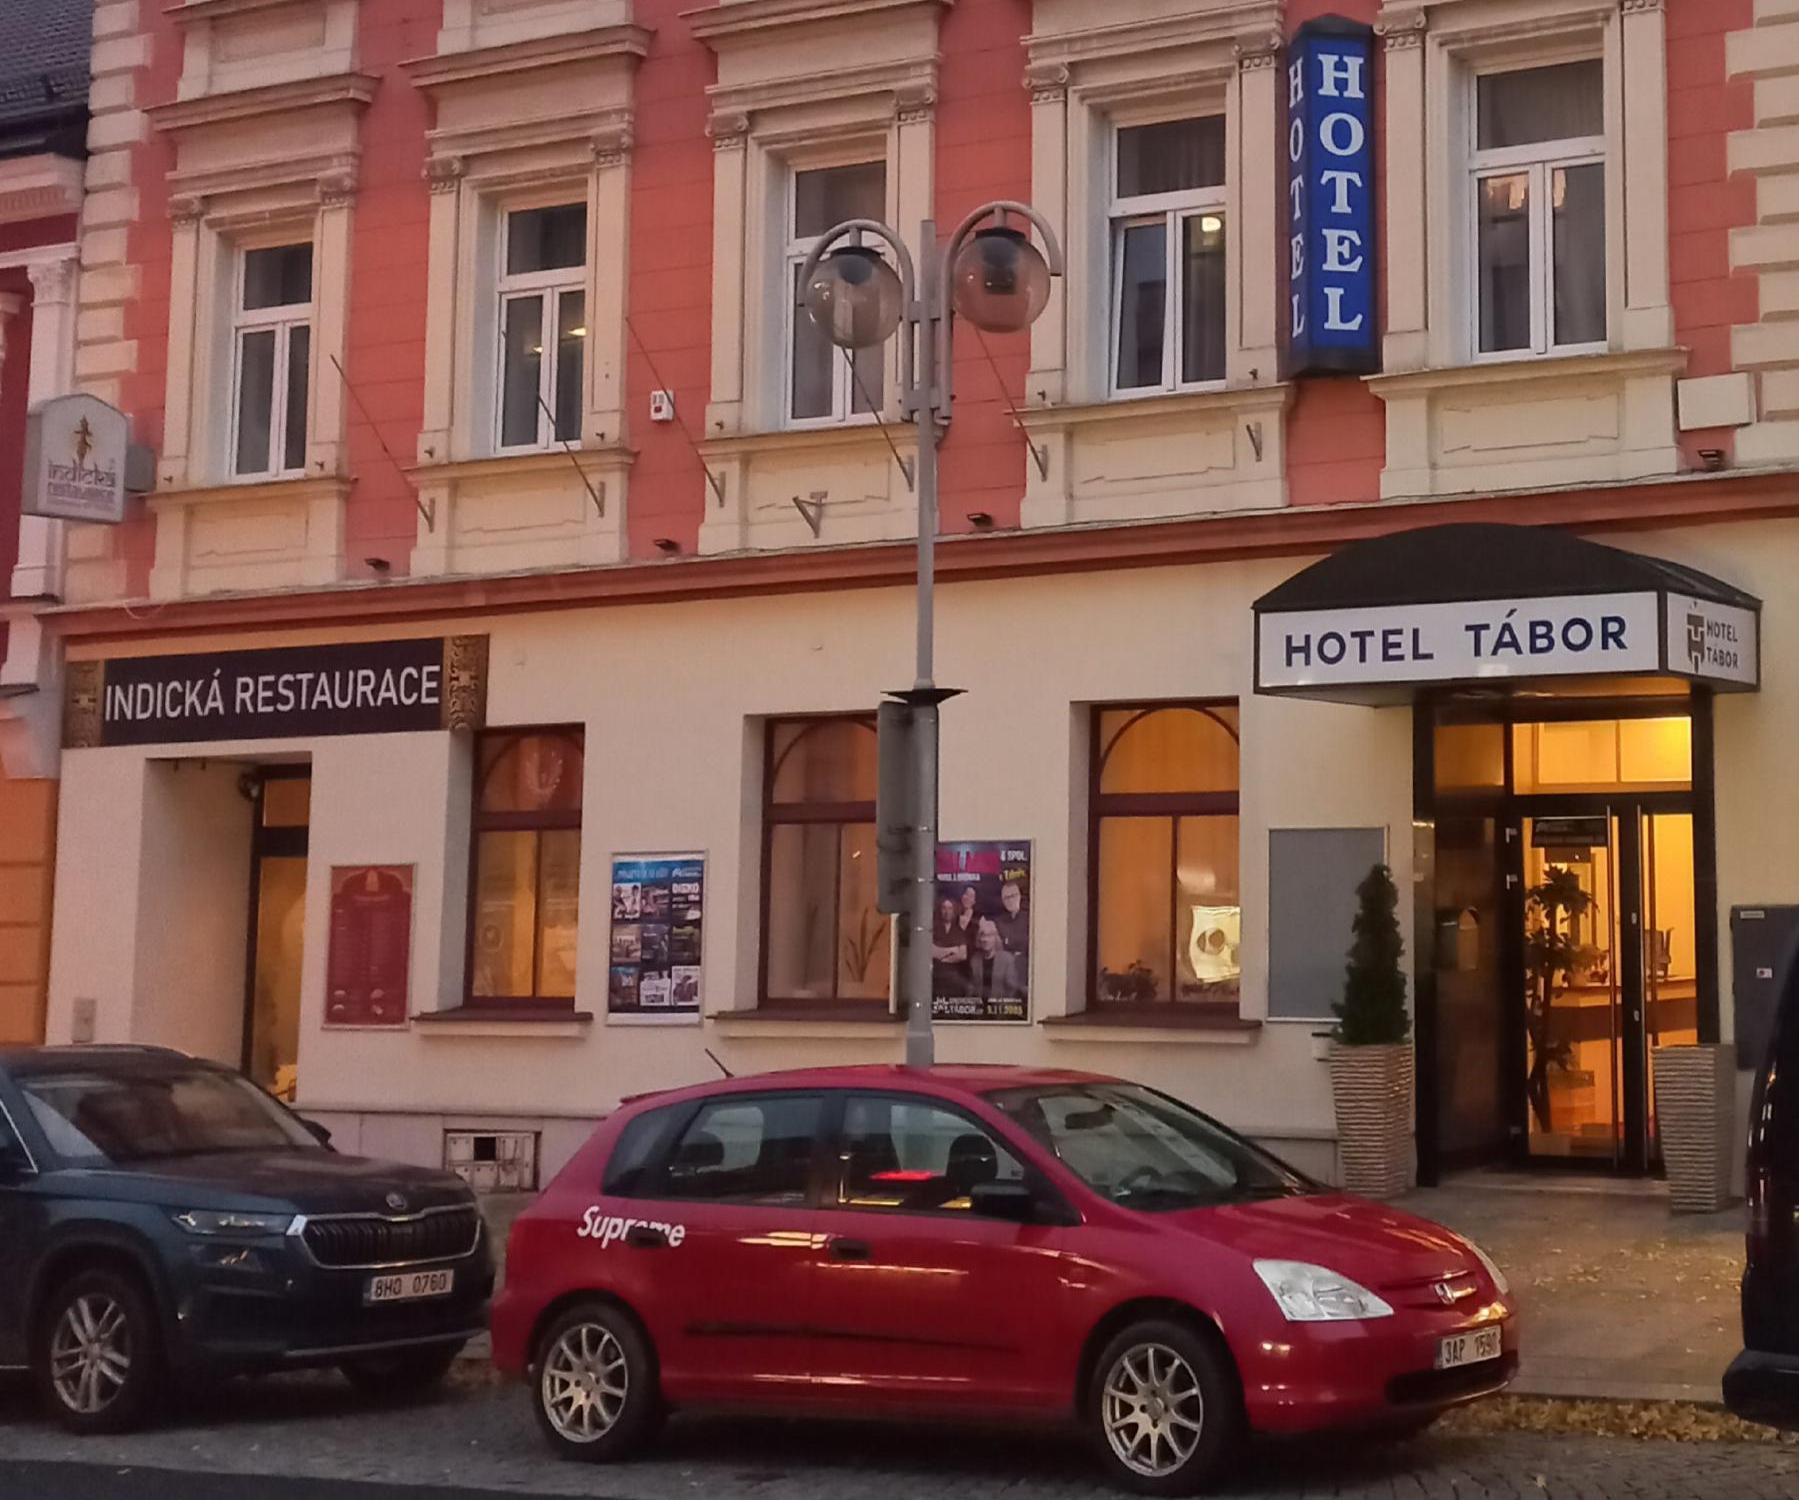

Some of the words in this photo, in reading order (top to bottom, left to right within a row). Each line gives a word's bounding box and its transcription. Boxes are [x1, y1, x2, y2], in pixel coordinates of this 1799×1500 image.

[1288, 56, 1305, 339] HOTEL
[1317, 53, 1364, 331] HOTEL
[1285, 627, 1435, 667] HOTEL
[1464, 608, 1628, 657] TÁBOR
[1706, 618, 1738, 643] HOTEL
[105, 668, 225, 722] INDICKÁ
[235, 665, 441, 714] RESTAURACE
[576, 1205, 686, 1249] Supre
